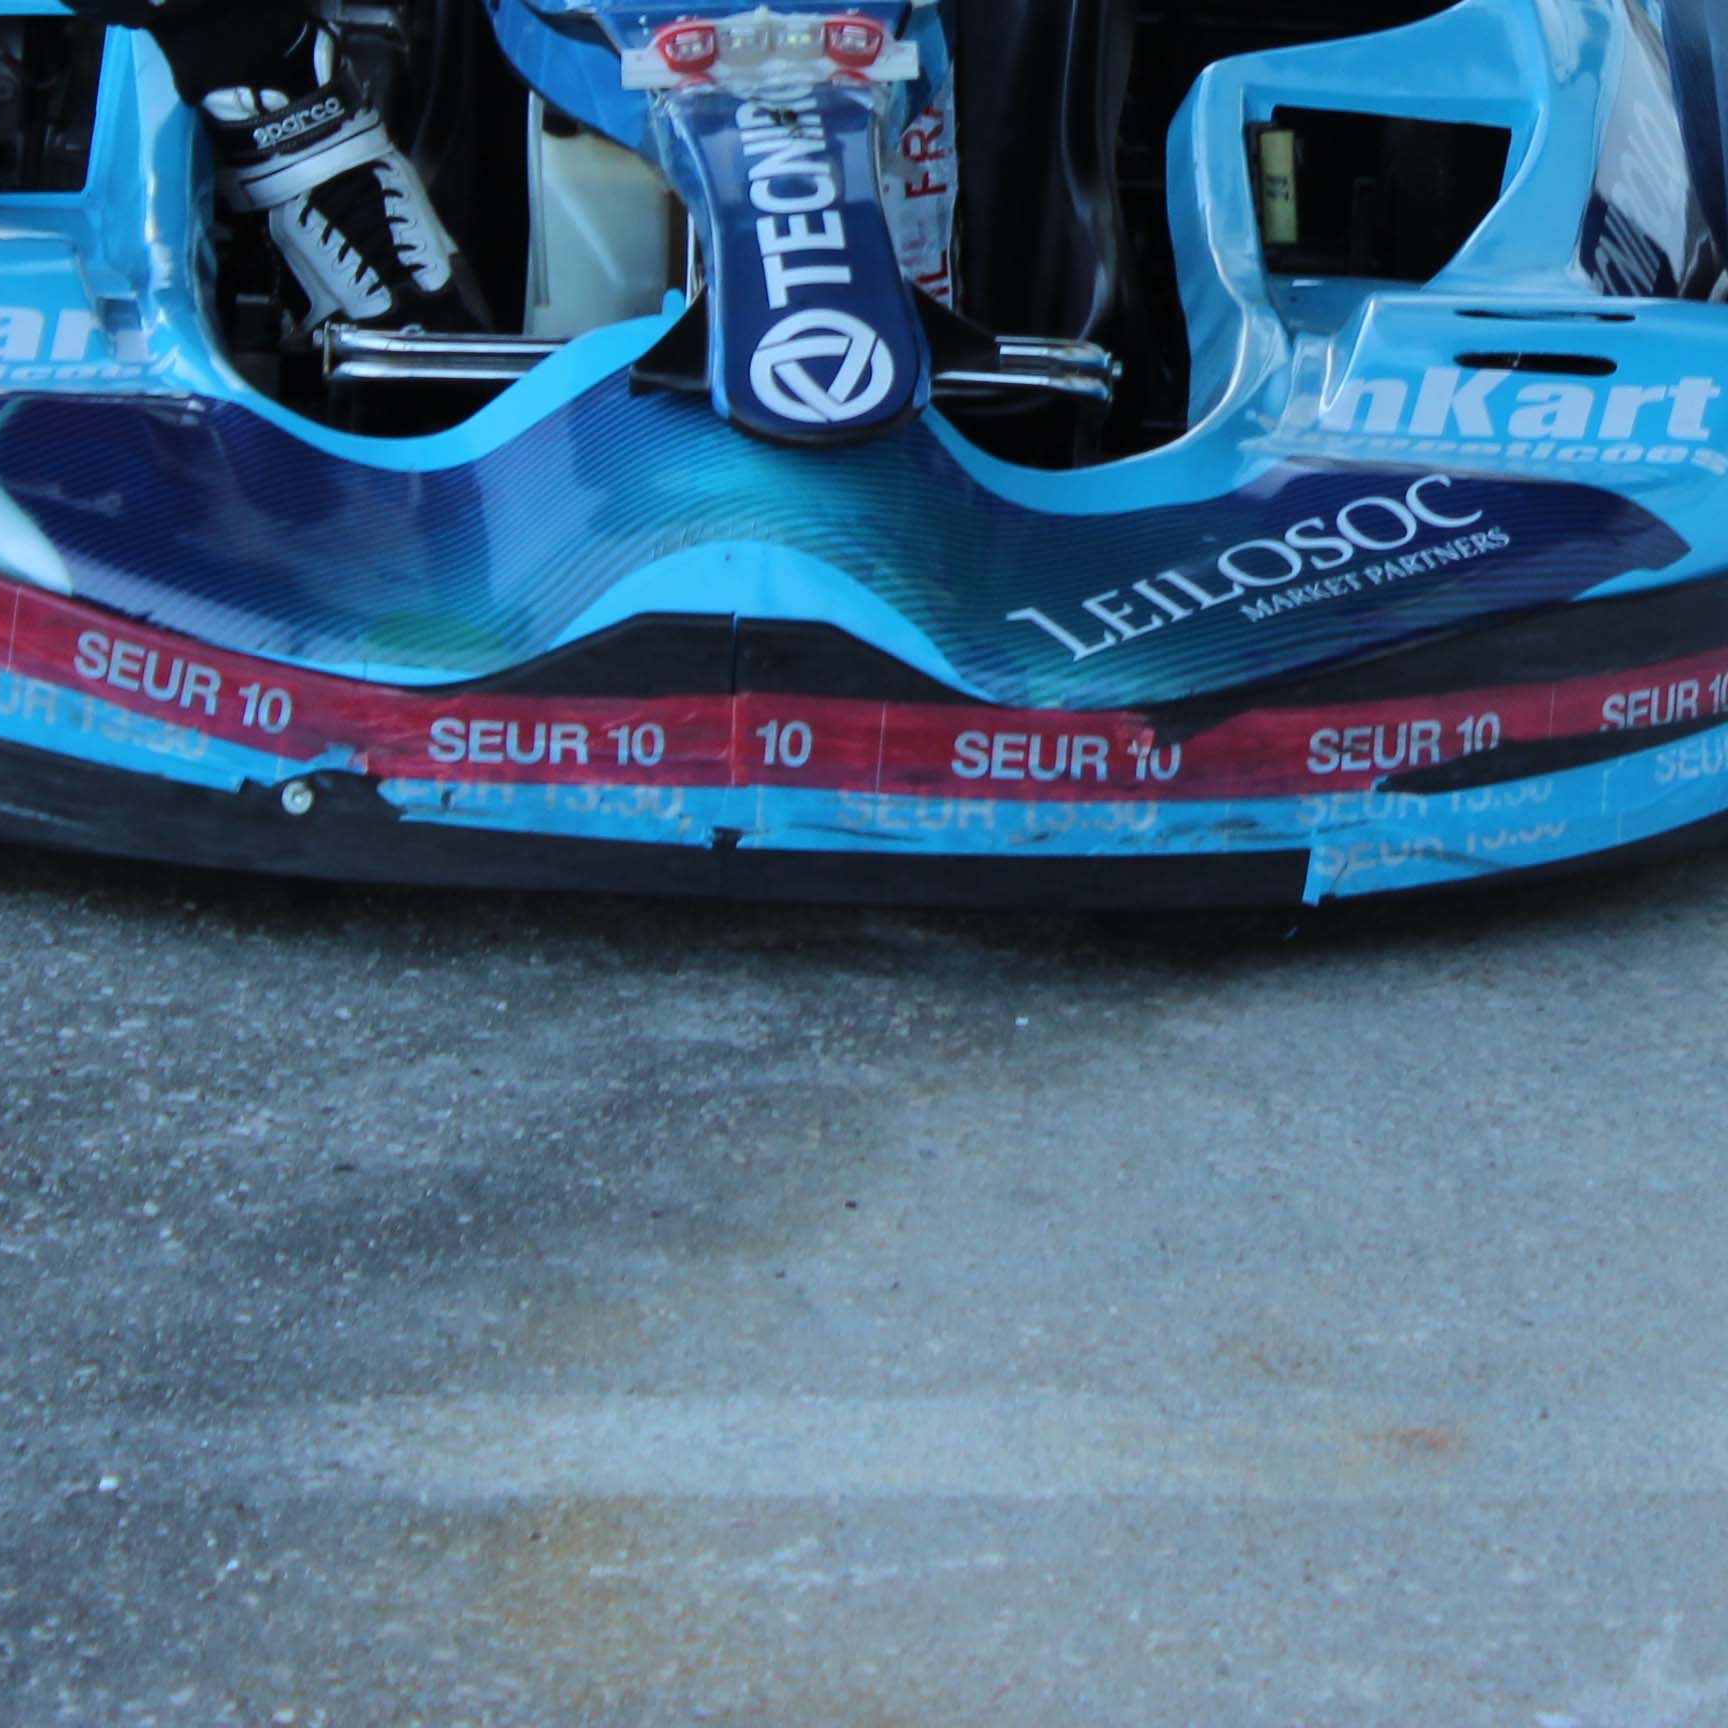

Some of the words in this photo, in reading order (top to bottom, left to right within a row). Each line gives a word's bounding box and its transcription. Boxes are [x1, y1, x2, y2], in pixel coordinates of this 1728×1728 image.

[252, 96, 341, 146] sparco
[1006, 474, 1484, 662] LEILOSOC
[1239, 571, 1364, 623] MARKET
[1364, 526, 1511, 586] PARTNERS
[73, 630, 221, 716] SEUR
[237, 684, 293, 734] 10
[1601, 684, 1700, 732] SEUR
[427, 716, 588, 765] SEUR
[608, 723, 665, 767] 10
[755, 720, 813, 768] 10
[951, 731, 1109, 781] SEUR
[1126, 740, 1182, 782] 10
[1306, 719, 1442, 774] SEUR
[1455, 712, 1501, 755] 10
